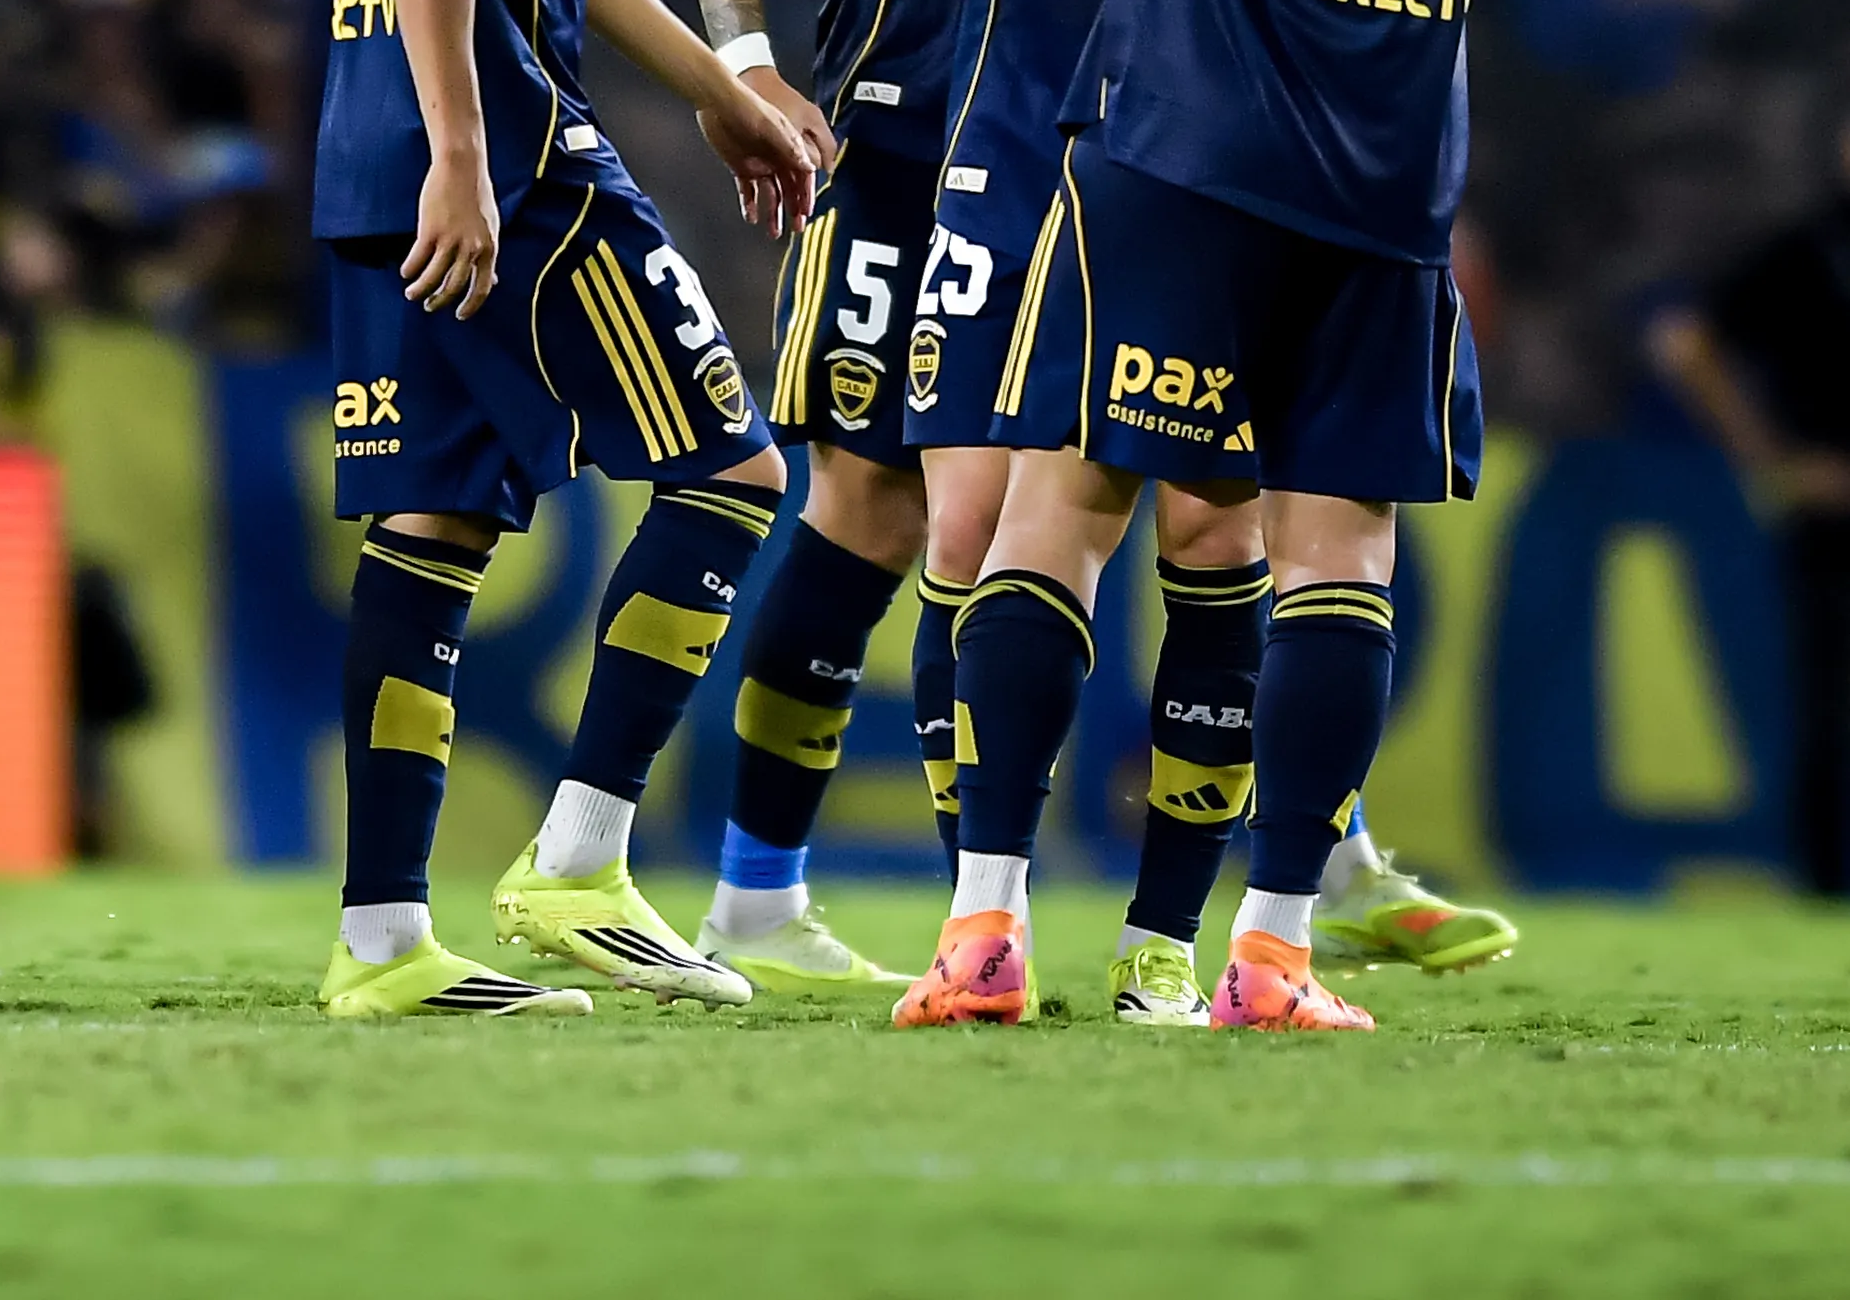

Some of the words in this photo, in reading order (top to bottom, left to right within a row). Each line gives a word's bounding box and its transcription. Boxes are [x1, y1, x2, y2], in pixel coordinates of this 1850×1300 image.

[644, 243, 722, 351] 3
[837, 239, 899, 346] 5
[334, 377, 402, 428] ax
[1108, 343, 1234, 414] pax
[1106, 402, 1214, 444] assistance
[701, 571, 737, 604] CA
